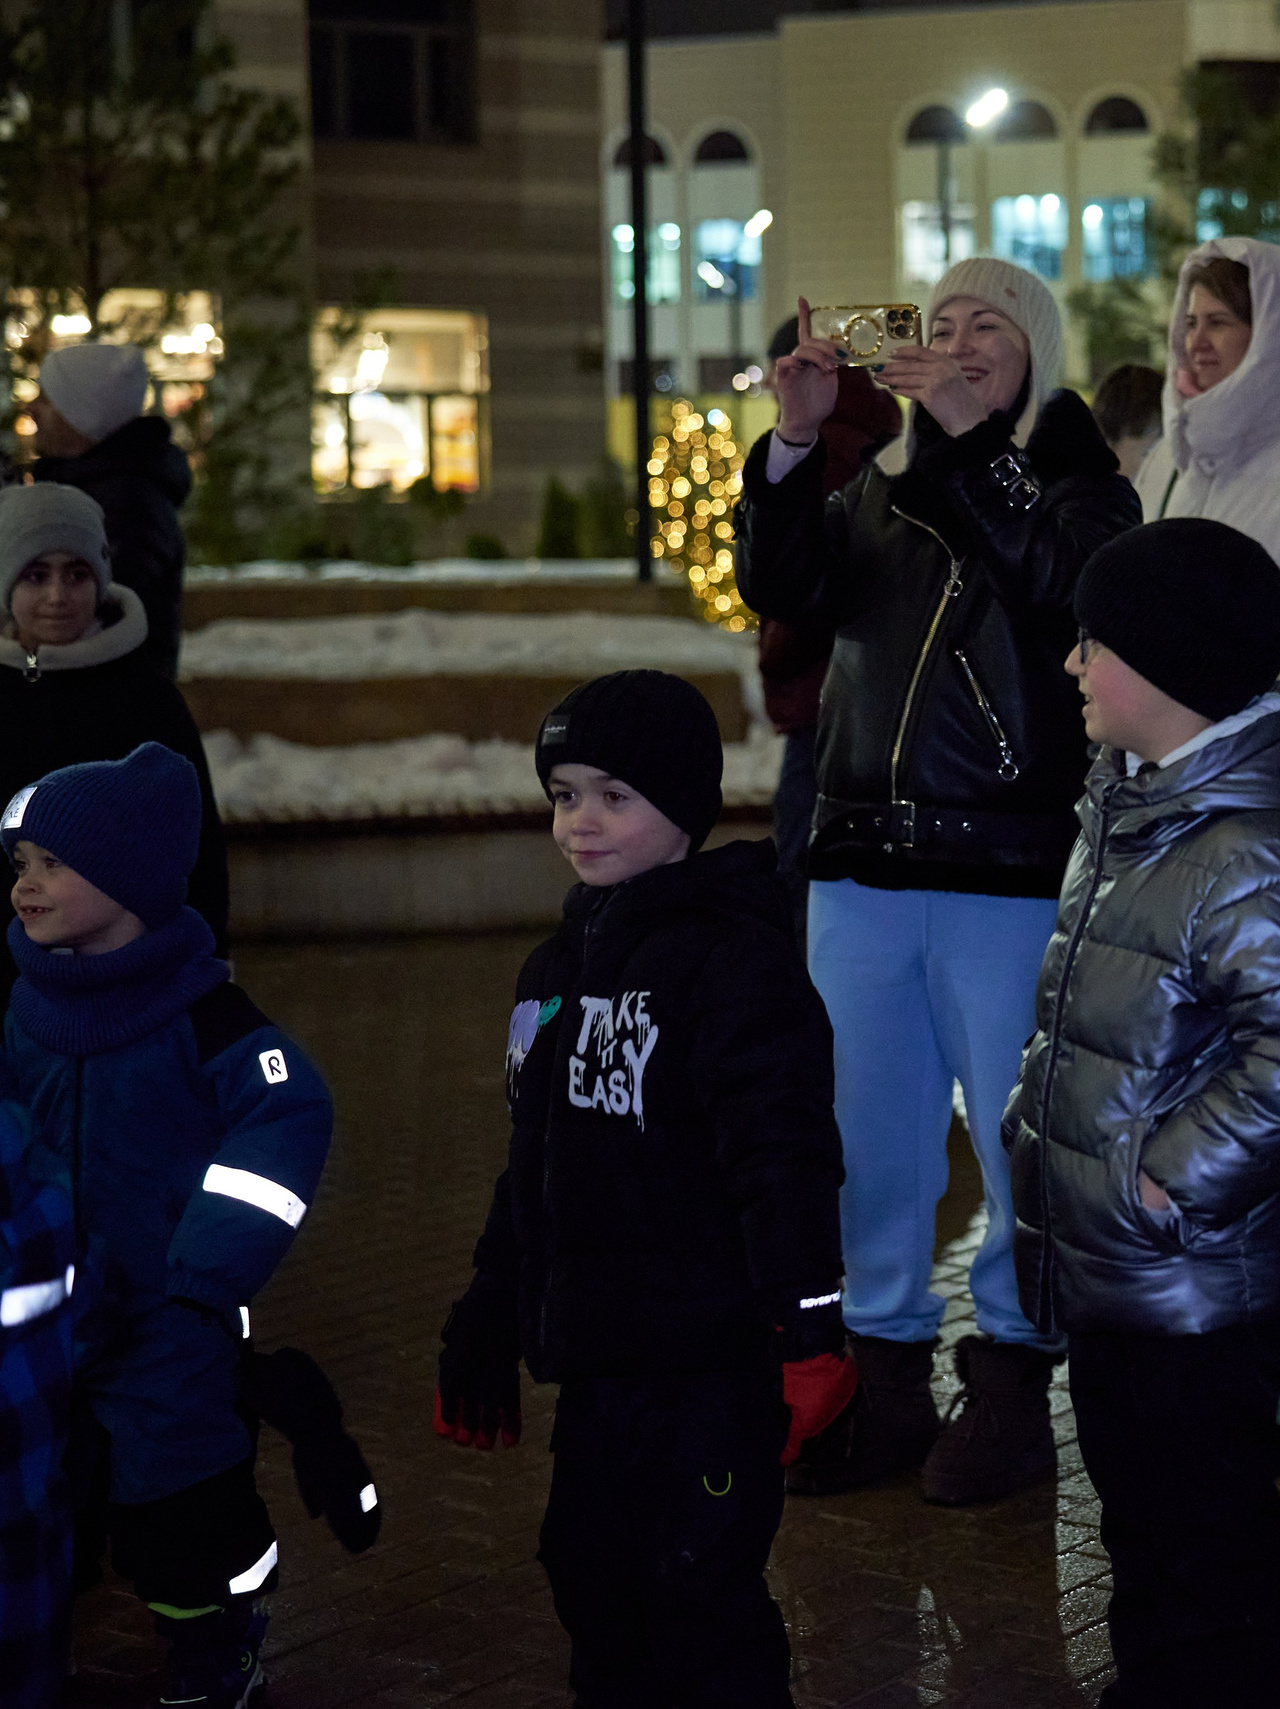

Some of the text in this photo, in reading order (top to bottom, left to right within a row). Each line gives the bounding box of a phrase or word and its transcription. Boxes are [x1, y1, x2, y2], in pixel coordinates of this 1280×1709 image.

[577, 991, 652, 1055] TAKE
[601, 1038, 618, 1069] IT
[569, 1025, 659, 1120] EASY
